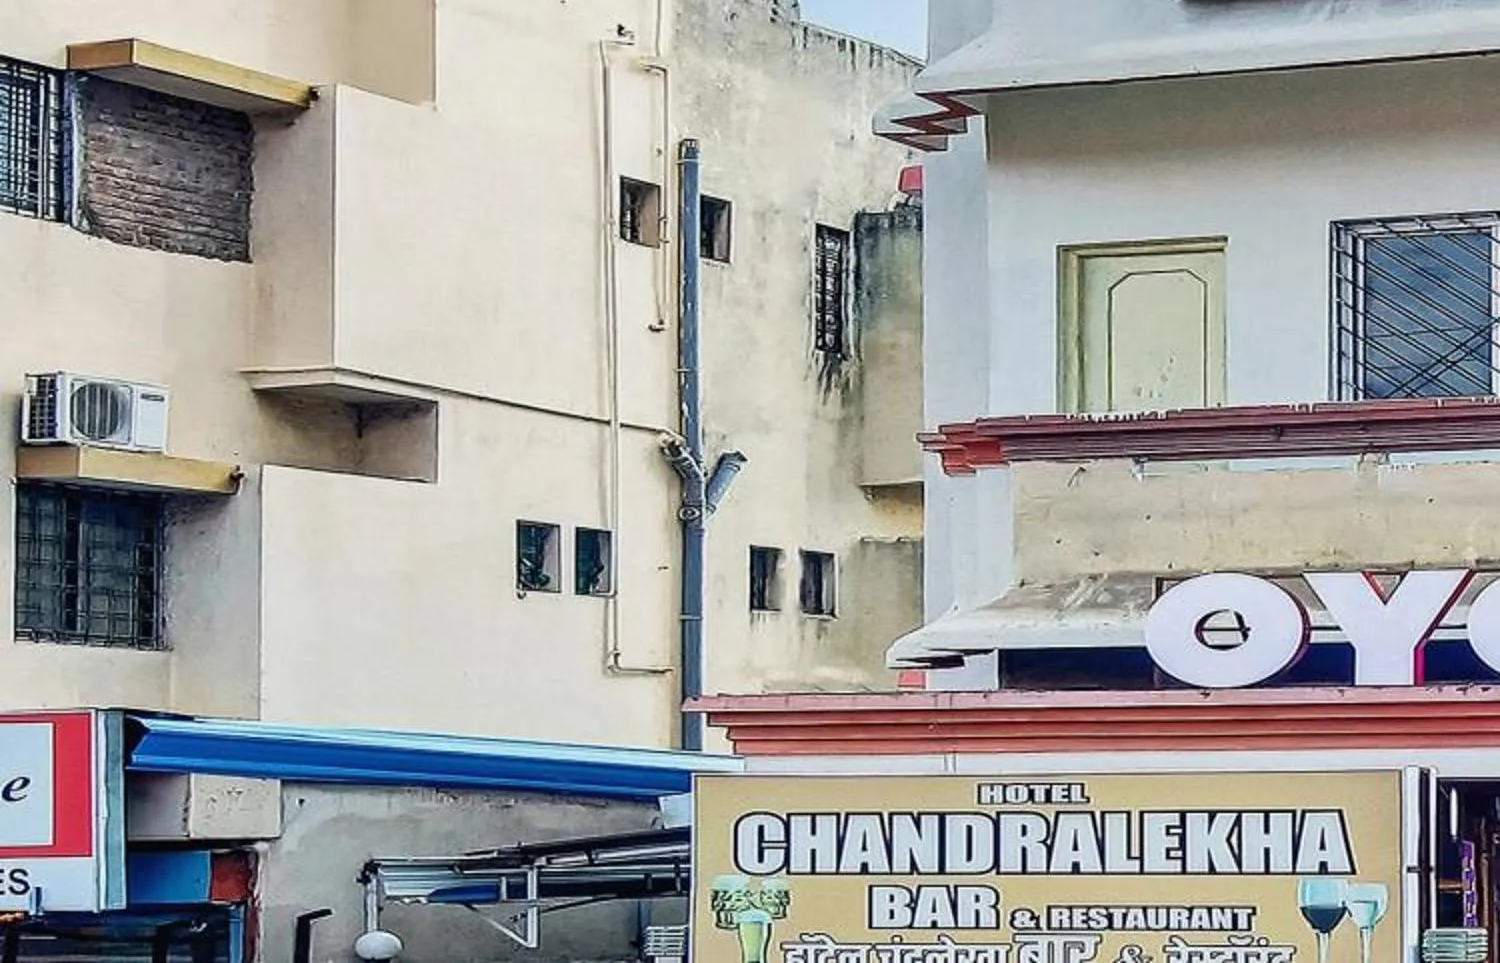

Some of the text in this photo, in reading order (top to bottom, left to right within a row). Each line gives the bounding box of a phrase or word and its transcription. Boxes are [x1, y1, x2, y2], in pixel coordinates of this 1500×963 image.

[977, 782, 1090, 806] HOTEL
[733, 809, 1357, 876] CHANDRALEKHA
[868, 884, 1256, 931] BAR & RESTAURANT
